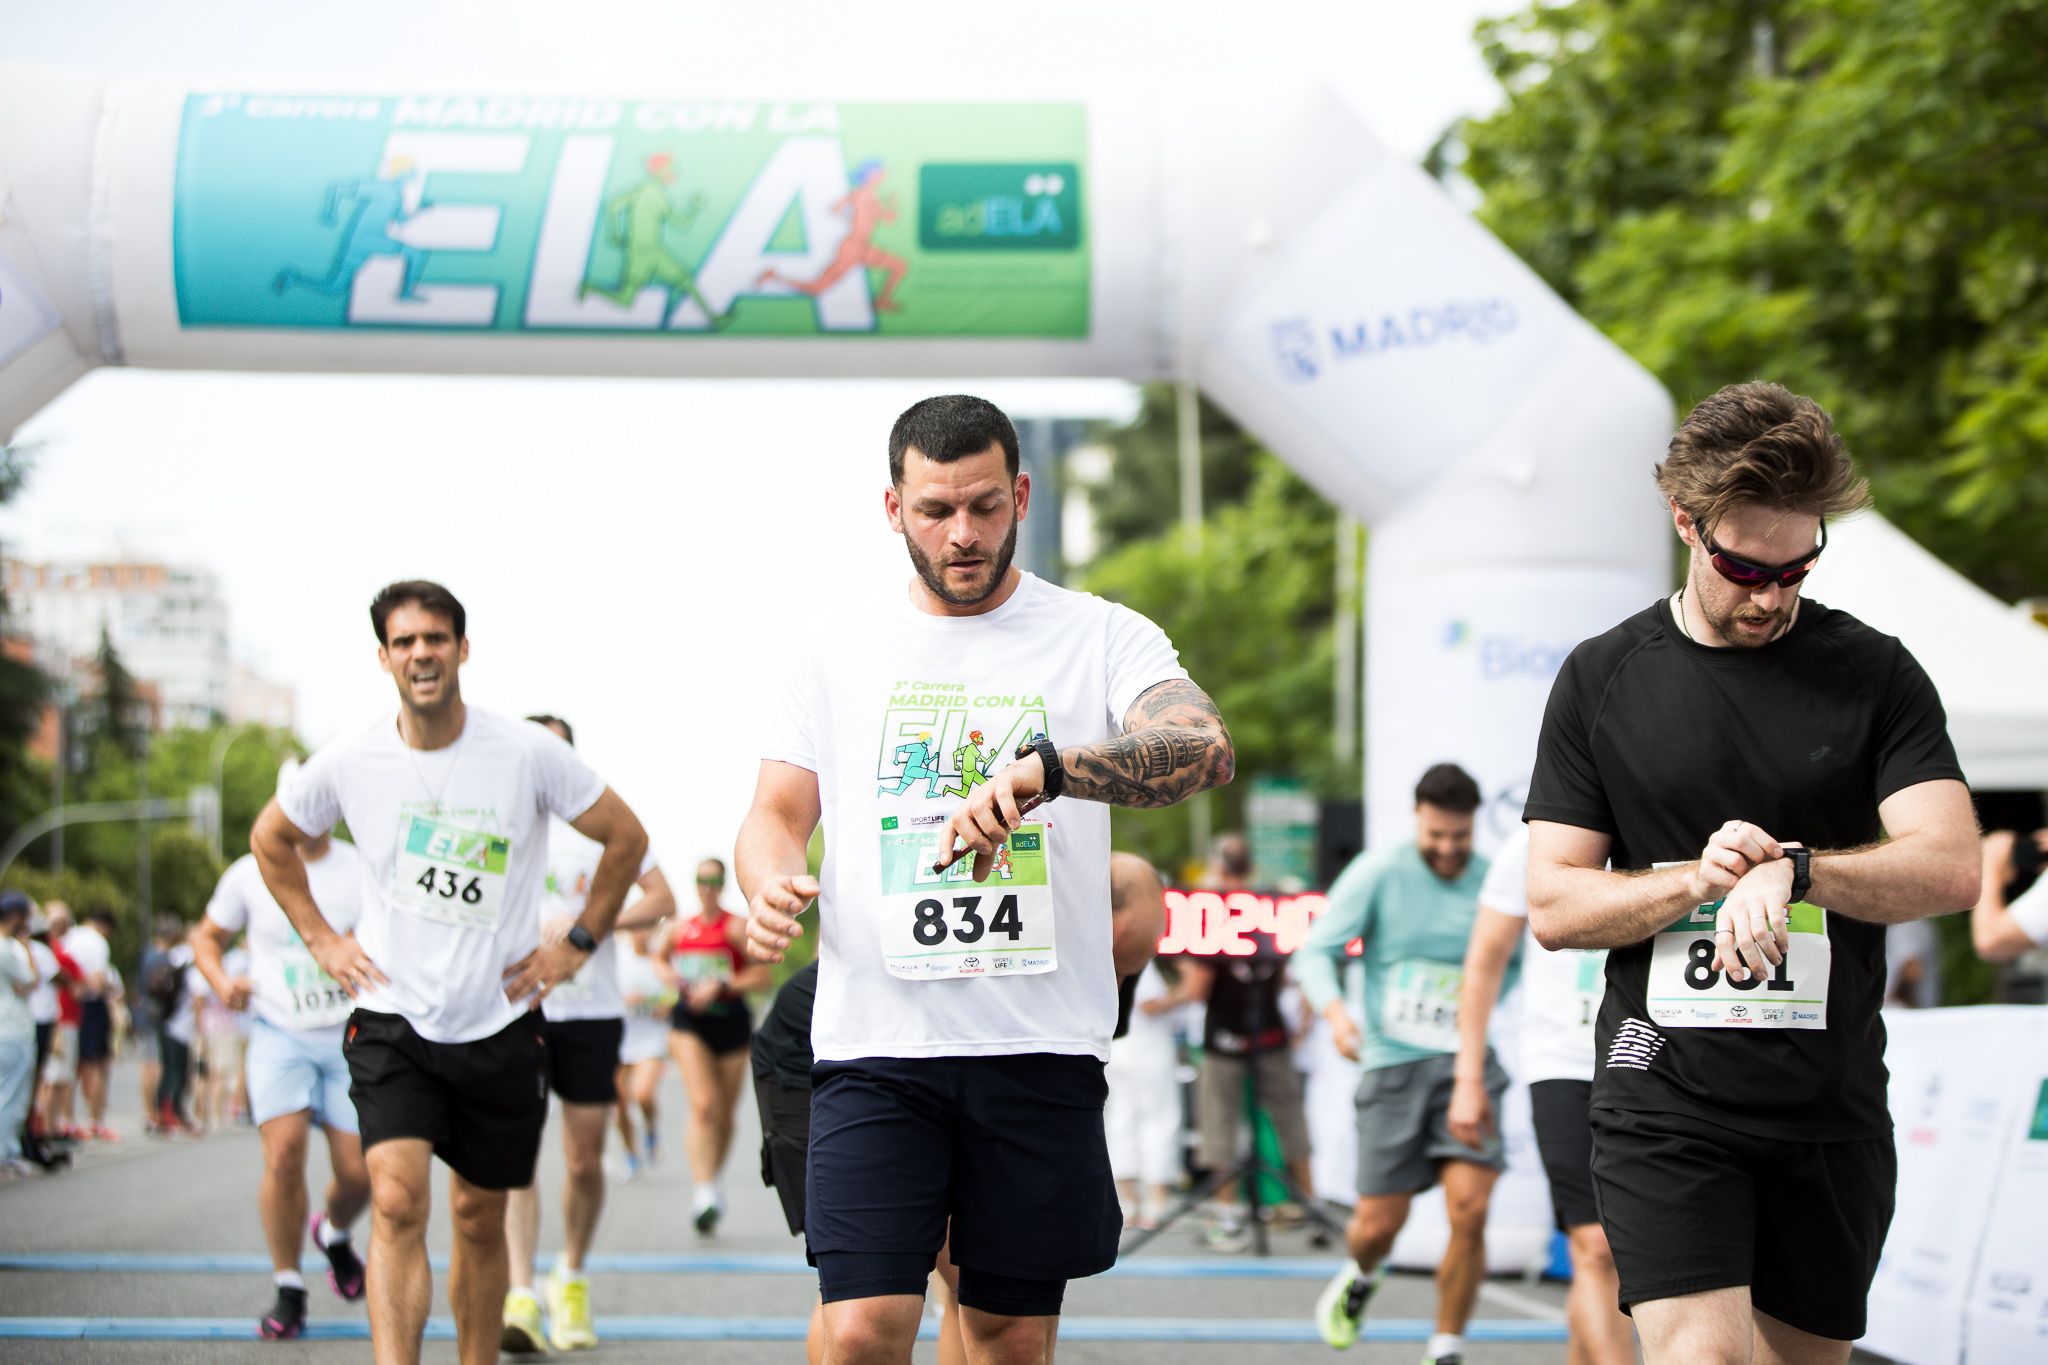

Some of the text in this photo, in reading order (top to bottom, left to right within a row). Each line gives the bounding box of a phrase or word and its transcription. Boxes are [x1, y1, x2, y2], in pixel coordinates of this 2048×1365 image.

[346, 132, 879, 331] ELA
[912, 681, 965, 692] Carrera
[889, 694, 1045, 708] MADRID CON LA
[1015, 840, 1037, 848] adELA
[416, 867, 483, 904] 436
[912, 894, 1023, 946] 834
